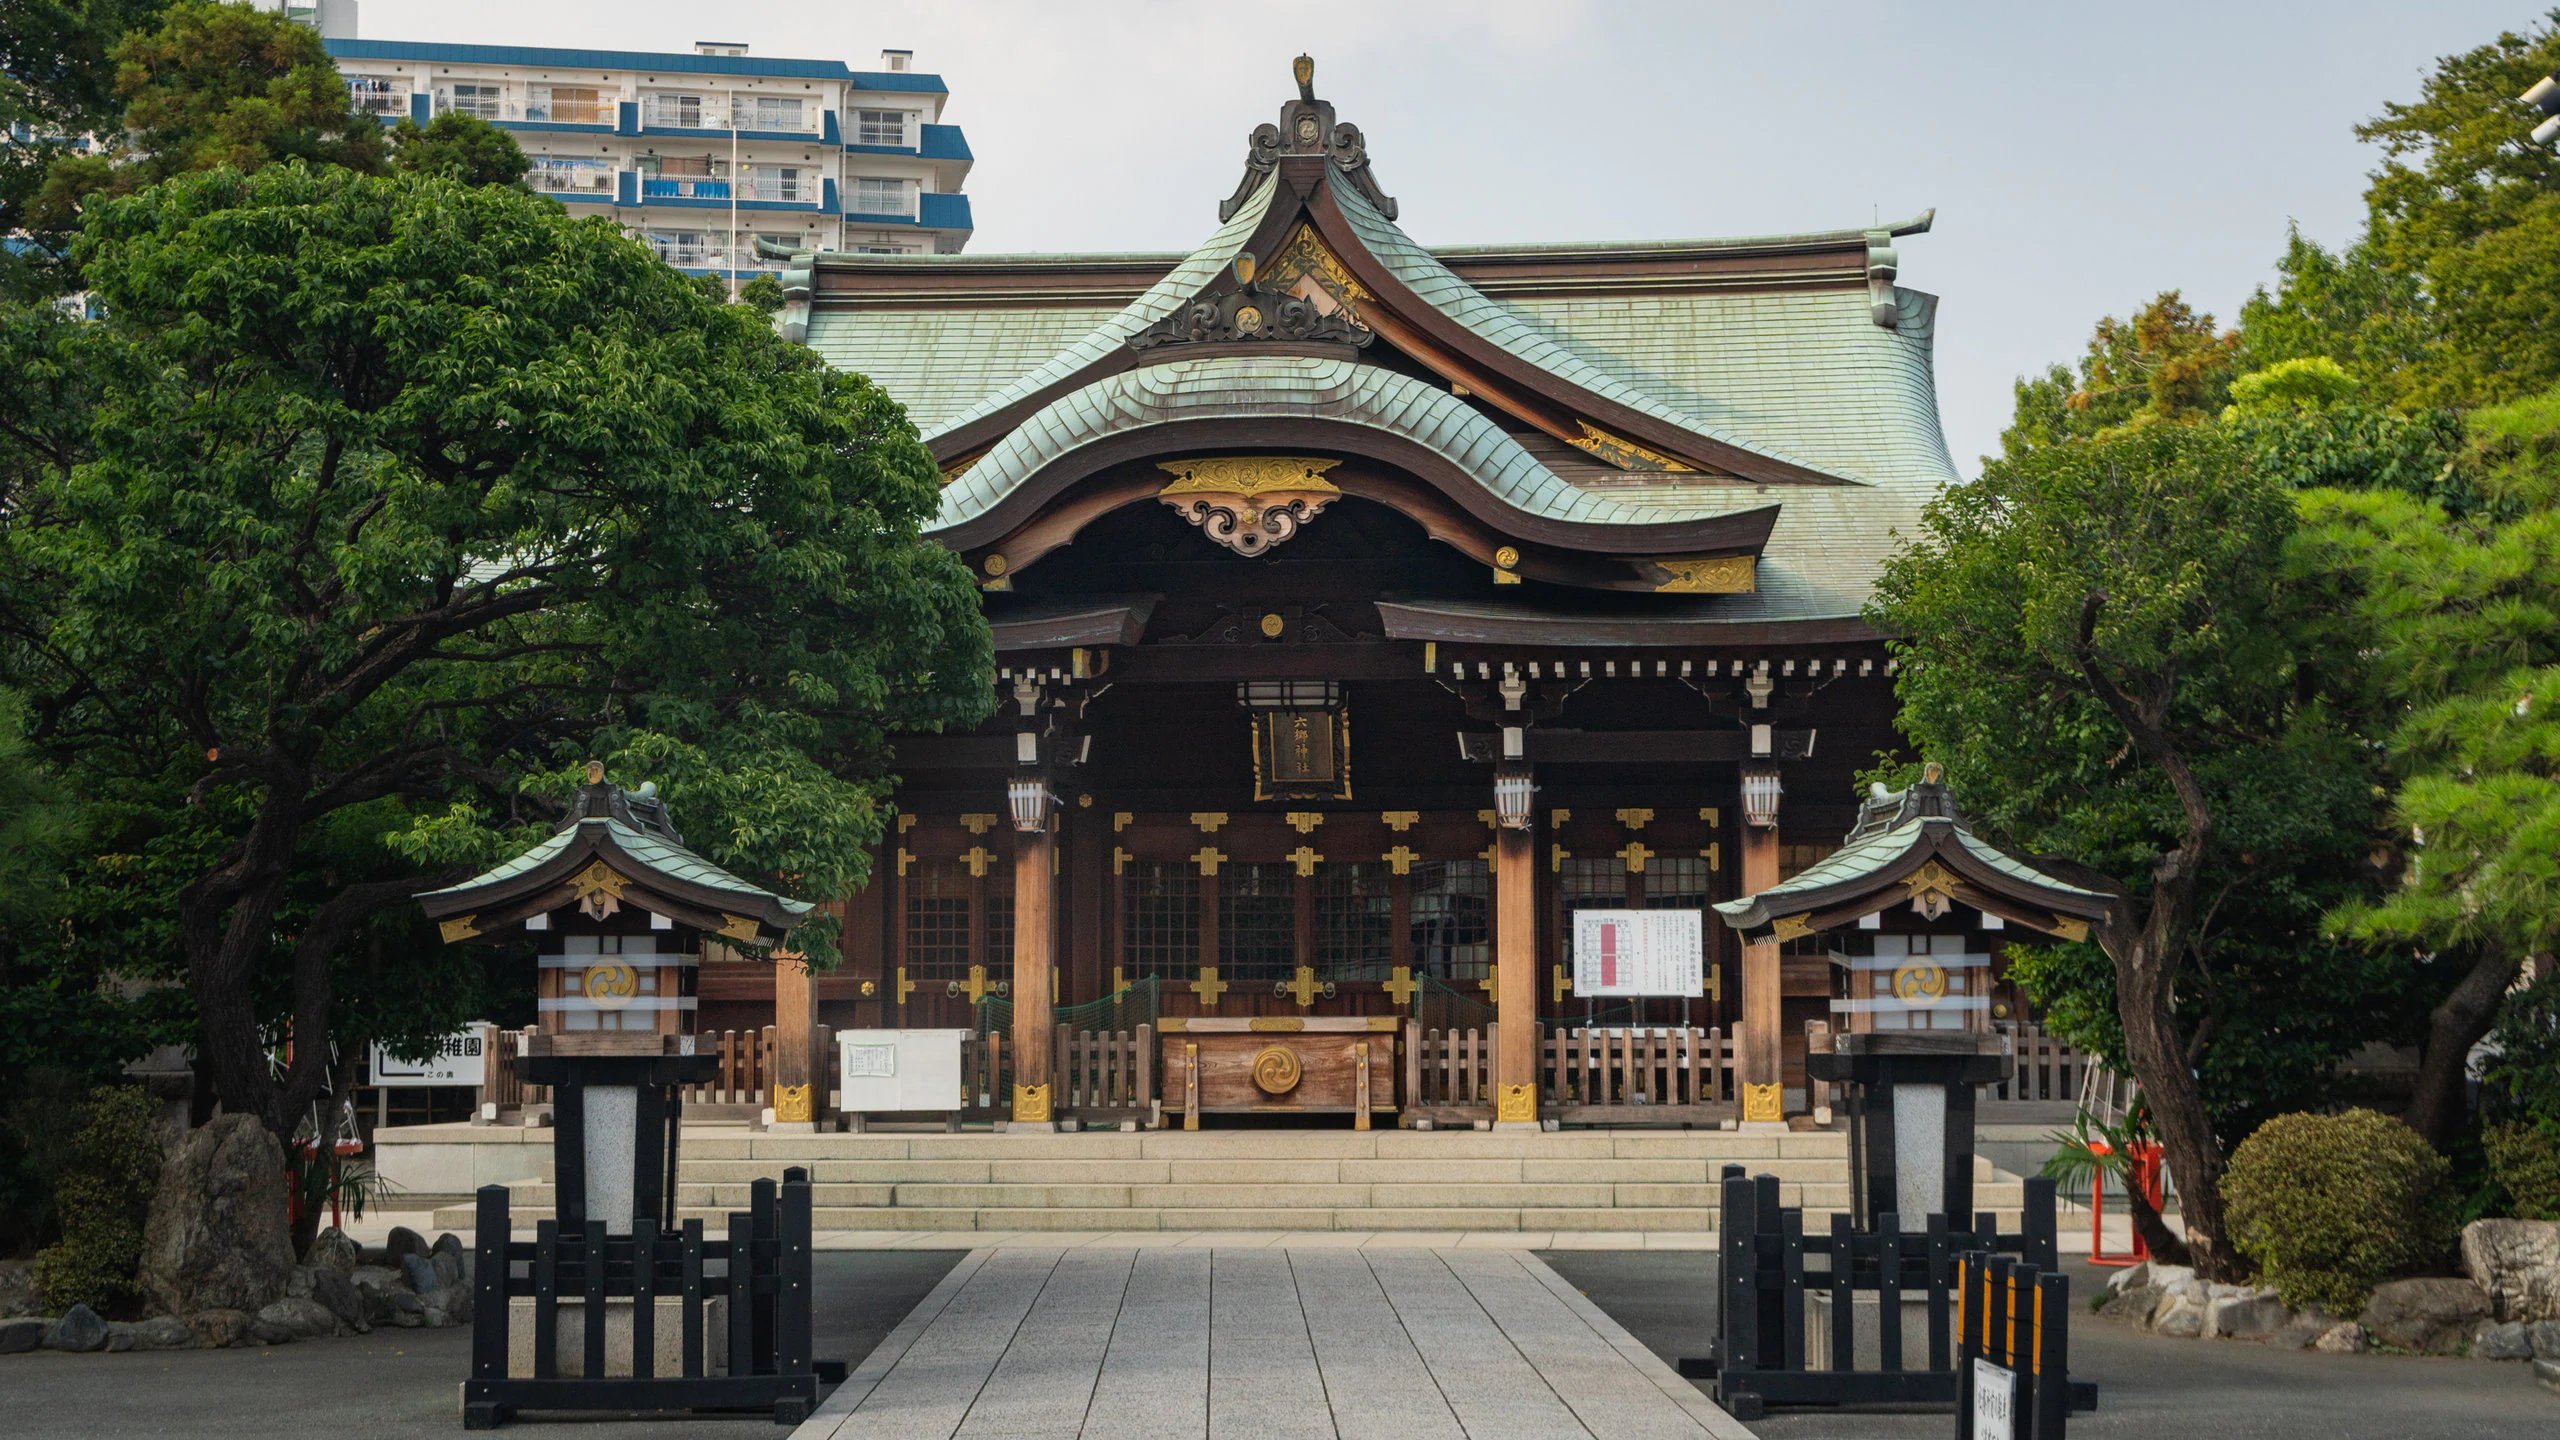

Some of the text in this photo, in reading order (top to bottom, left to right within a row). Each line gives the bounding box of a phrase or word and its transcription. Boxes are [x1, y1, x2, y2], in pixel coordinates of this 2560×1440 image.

[1294, 716, 1310, 774] 六郷神社
[440, 1036, 482, 1056] 稚園
